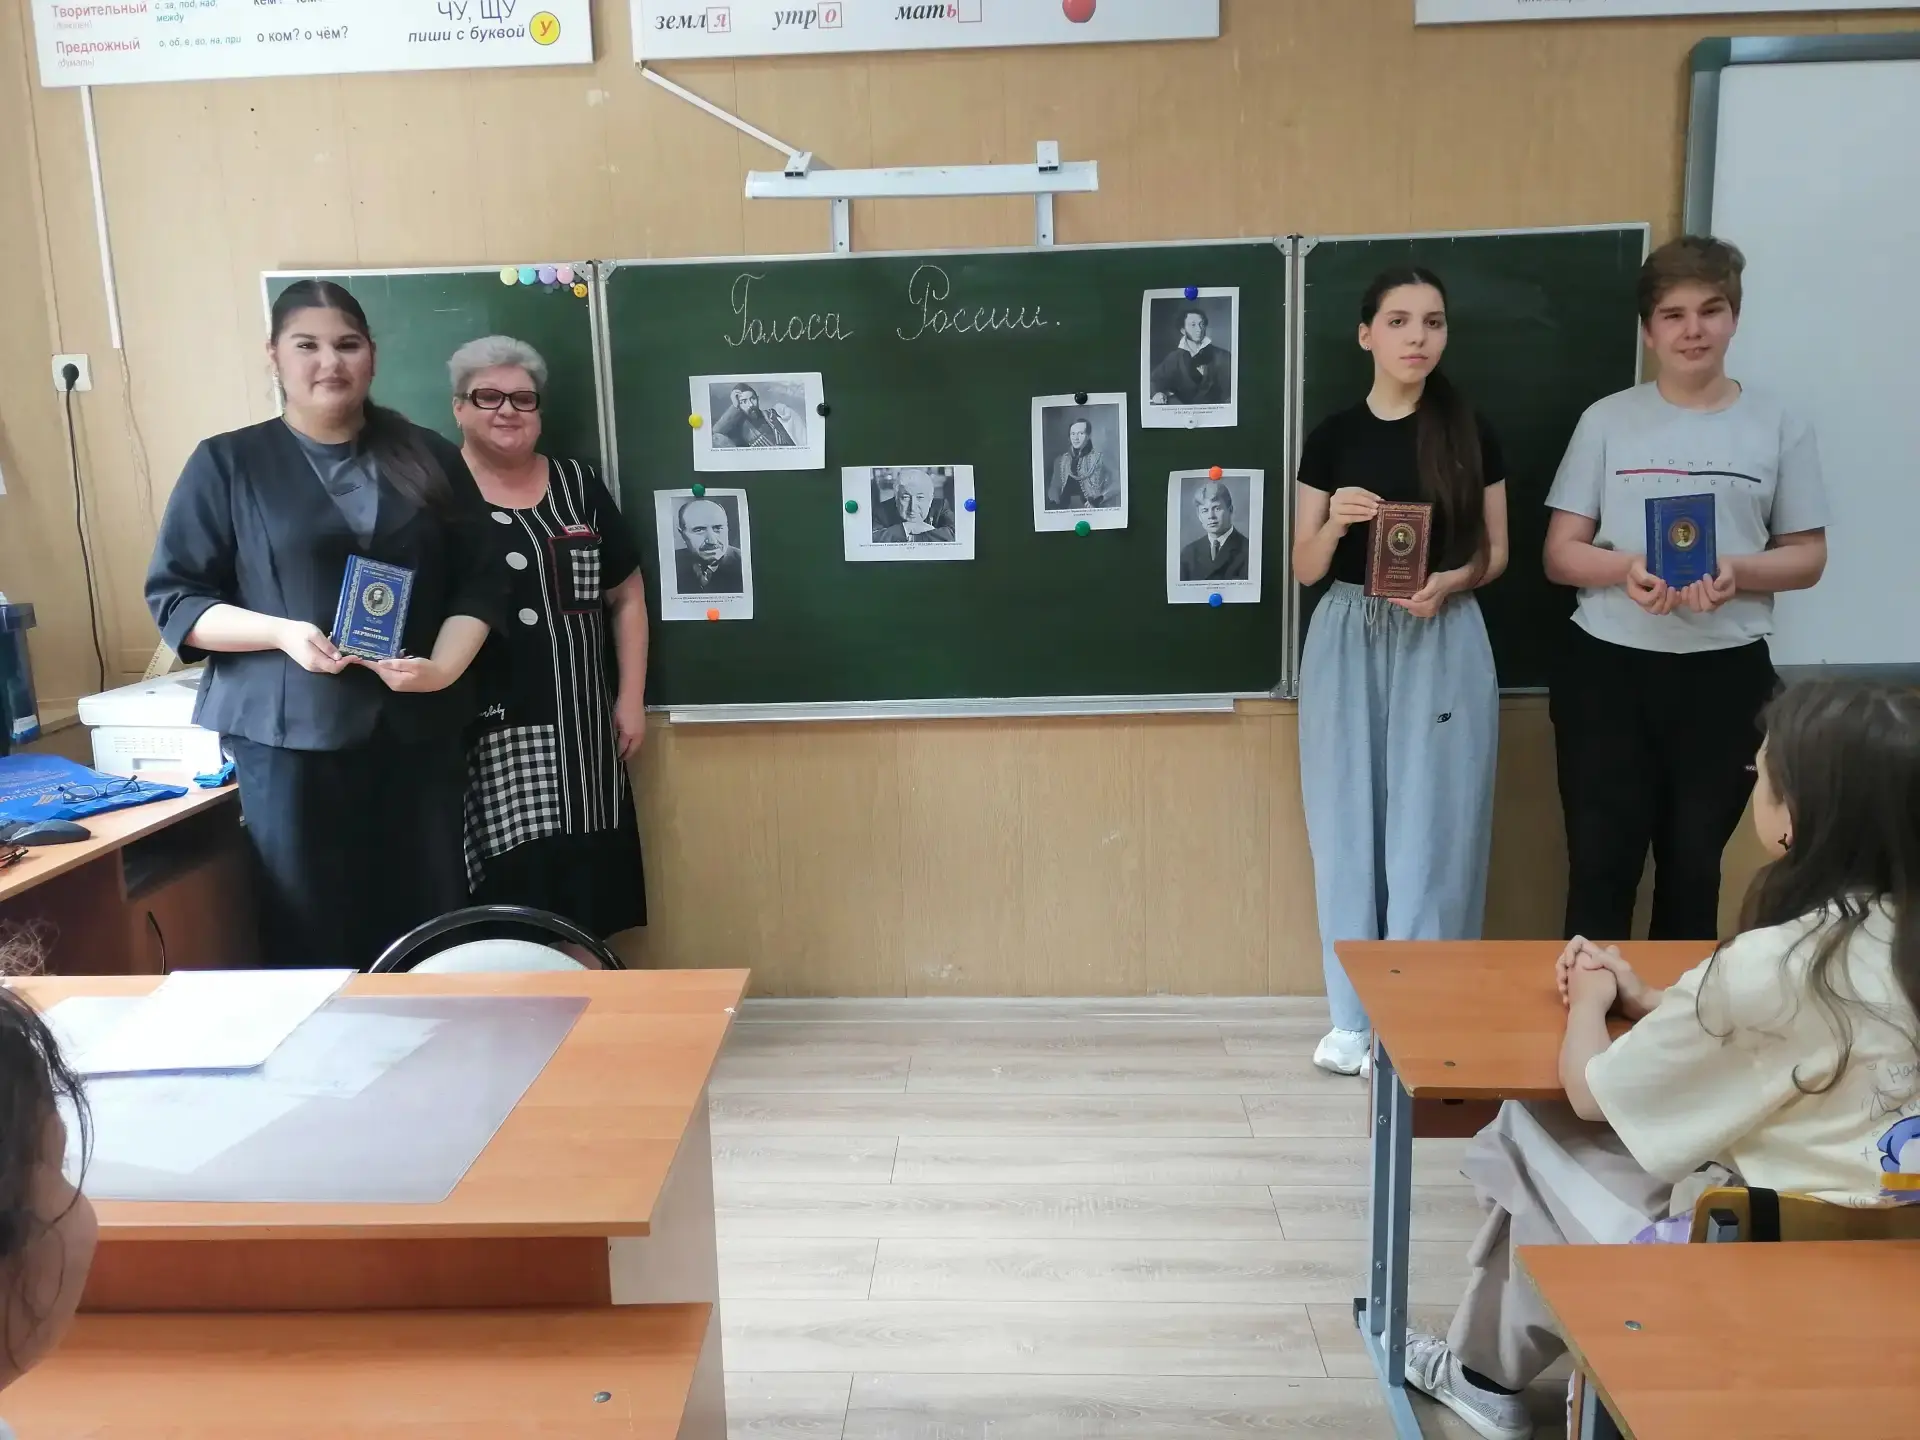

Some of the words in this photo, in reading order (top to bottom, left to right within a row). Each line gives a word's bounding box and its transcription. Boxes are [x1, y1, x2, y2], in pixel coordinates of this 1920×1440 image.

[51, 1, 148, 18] Творительный
[156, 12, 184, 23] между
[895, 4, 956, 20] мать
[257, 33, 265, 42] о
[268, 28, 300, 42] ком?
[304, 31, 312, 40] о
[316, 25, 348, 39] чём?
[408, 30, 451, 42] пиши
[456, 30, 465, 40] с
[470, 24, 525, 42] буквой
[56, 38, 140, 54] Предложный
[724, 273, 854, 347] Голоса
